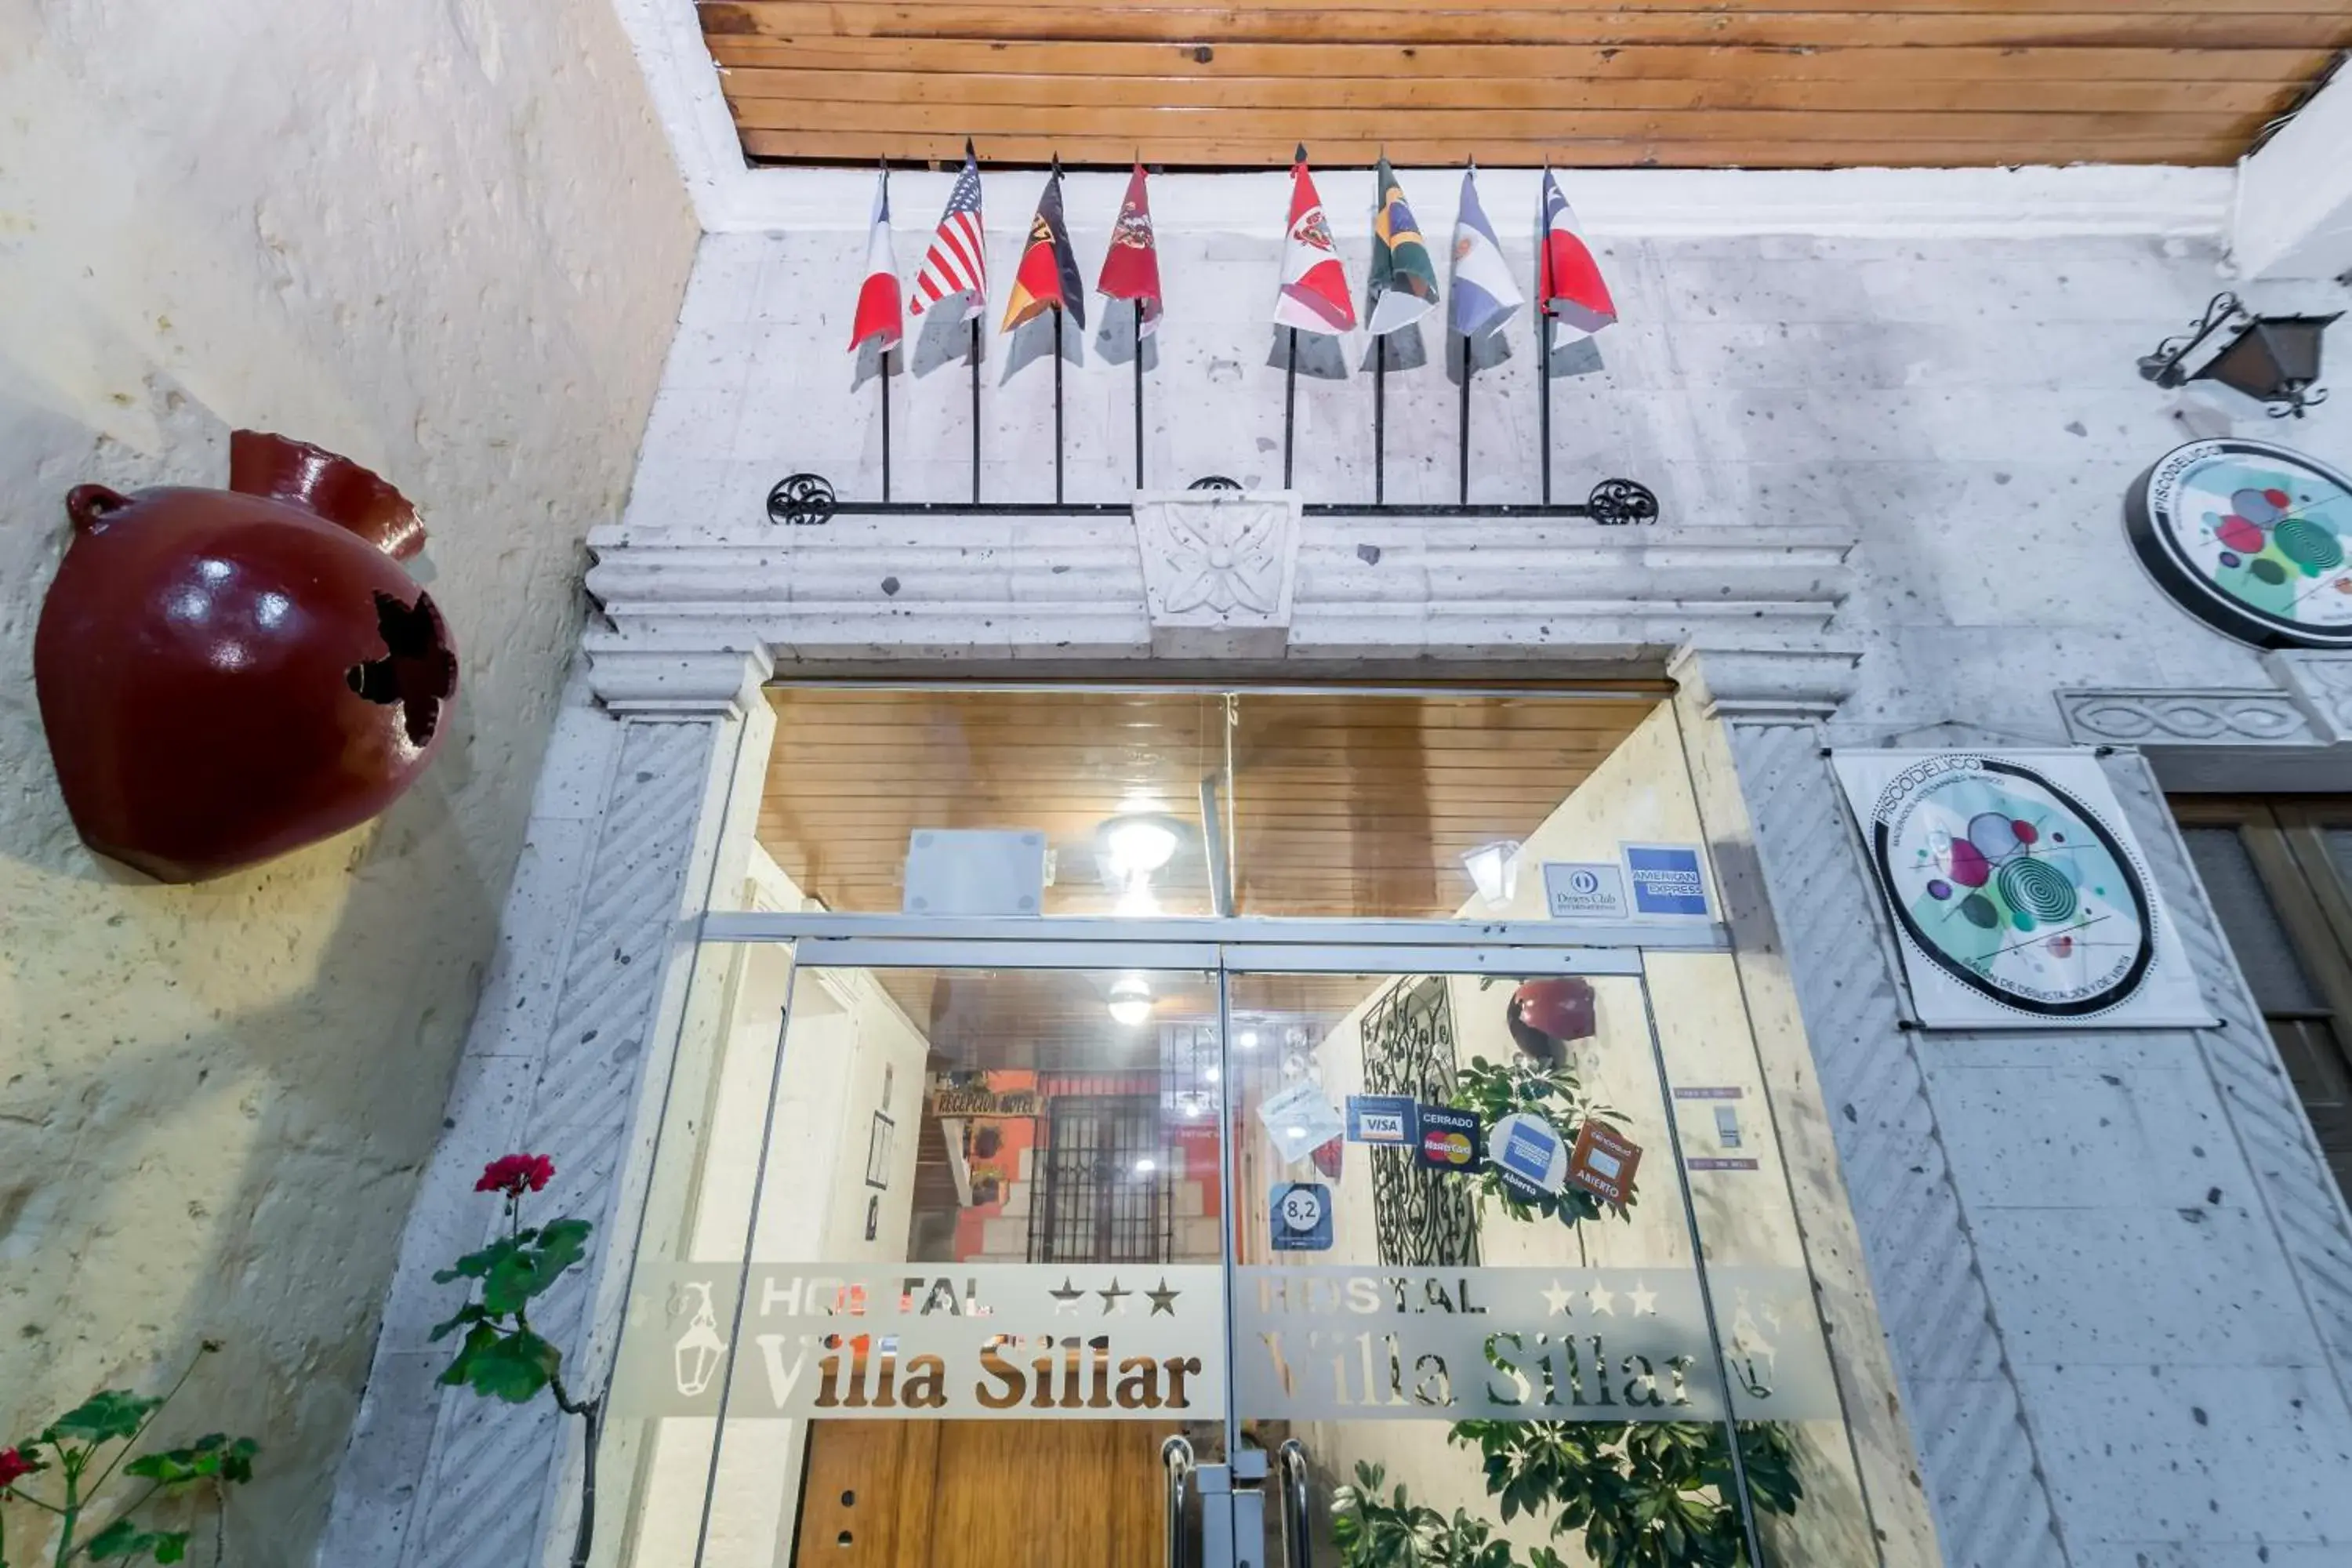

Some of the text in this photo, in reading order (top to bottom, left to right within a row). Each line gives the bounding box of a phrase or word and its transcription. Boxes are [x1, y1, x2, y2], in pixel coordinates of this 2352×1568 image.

[1633, 871, 1697, 882] AMERICAN
[1649, 884, 1703, 895] EXPRESS
[1367, 1119, 1397, 1131] VISA
[1423, 1113, 1473, 1128] CERRADO
[1503, 1172, 1537, 1196] Abierto
[1577, 1169, 1619, 1198] ABIERTO
[1287, 1200, 1316, 1220] 8,2
[1258, 1276, 1490, 1315] HOSTAL
[756, 1333, 1202, 1410] Villa Sillar
[1256, 1331, 1697, 1408] Villa Sillar
